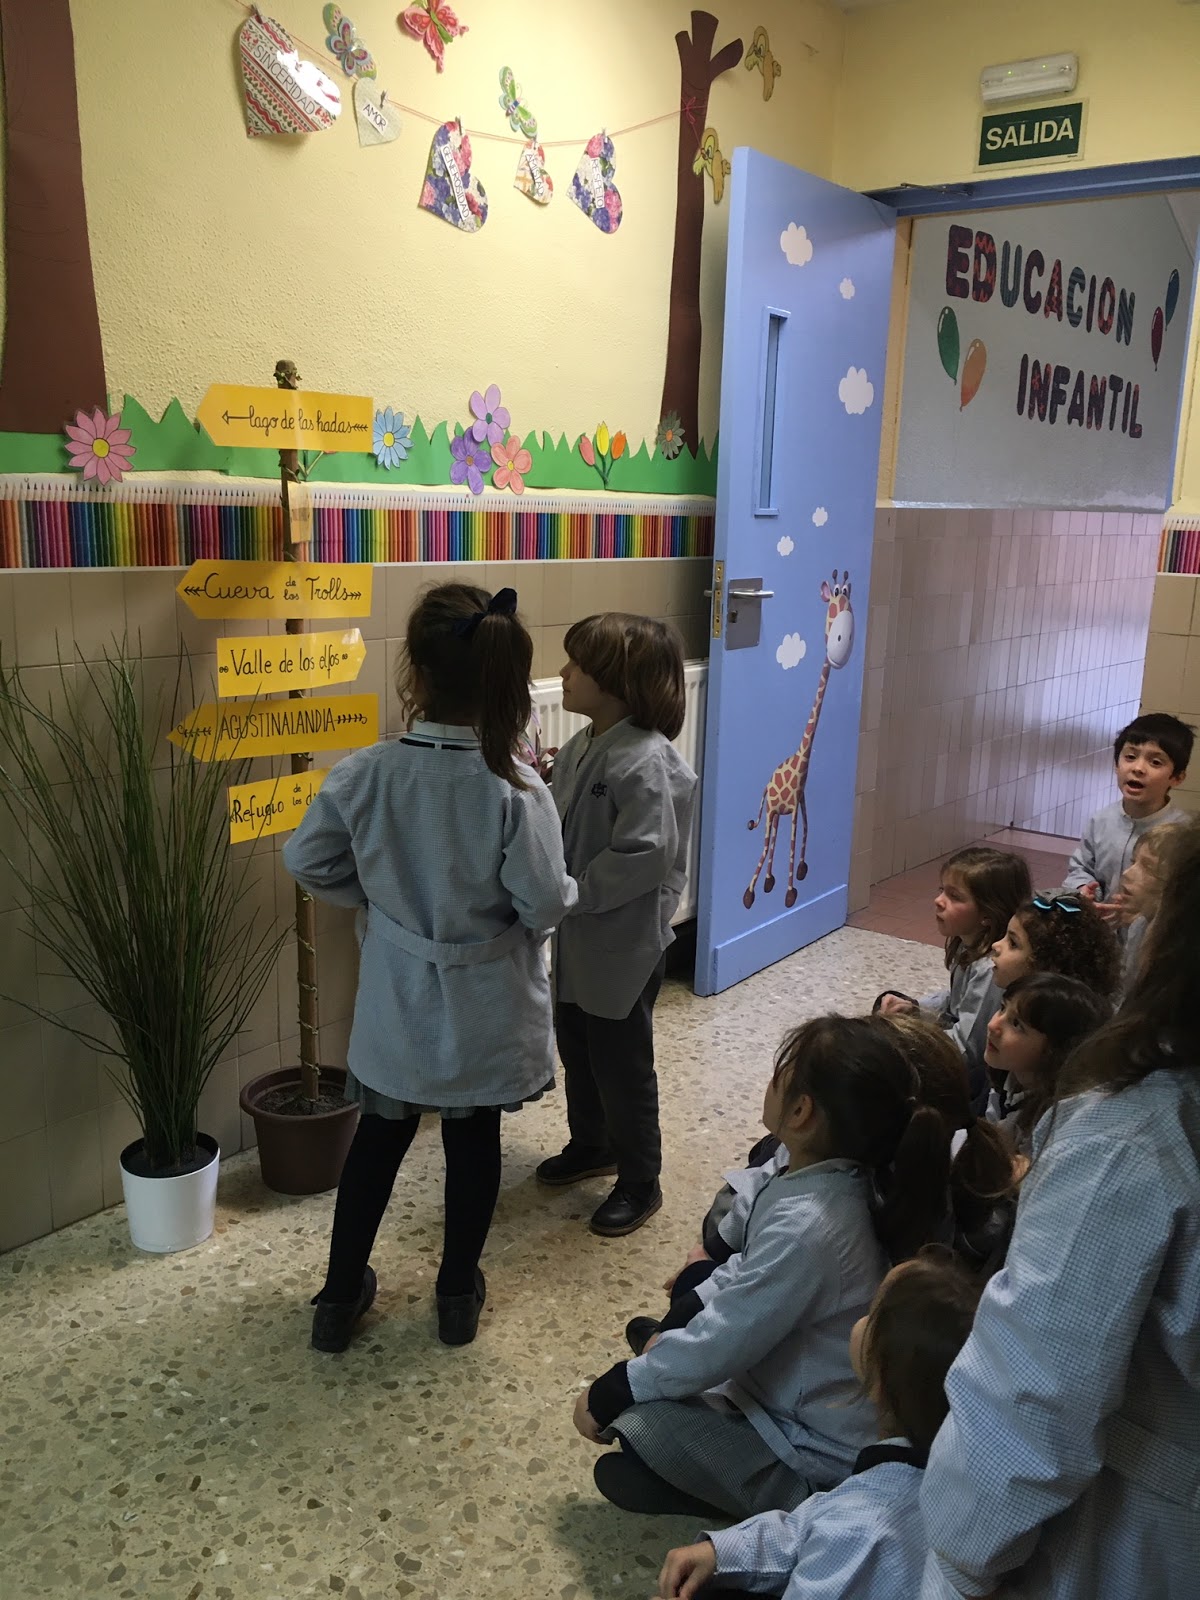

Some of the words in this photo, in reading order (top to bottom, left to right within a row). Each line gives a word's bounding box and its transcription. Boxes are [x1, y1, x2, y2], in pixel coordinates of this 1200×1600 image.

[253, 44, 315, 115] SINCERIDAD
[363, 103, 387, 132] AMOR
[985, 117, 1074, 151] SALIDA
[442, 146, 470, 219] GENEROSIDAD
[525, 153, 544, 196] AMISTAD
[591, 158, 604, 208] RESPETO
[946, 224, 1136, 346] EDUCACION
[1016, 353, 1143, 438] INFANTIL
[281, 409, 295, 430] de
[298, 408, 315, 431] las
[316, 410, 352, 434] hadas
[204, 572, 274, 600] Cueva
[283, 590, 300, 601] los
[285, 576, 297, 587] de
[305, 576, 348, 601] Trolls
[230, 649, 273, 676] Valle
[279, 648, 294, 674] de
[299, 648, 315, 672] los
[318, 644, 340, 680] elfos
[219, 707, 336, 741] AGUSTINALANDIA
[292, 796, 302, 806] los
[293, 783, 302, 793] de
[233, 795, 285, 831] Refugio
